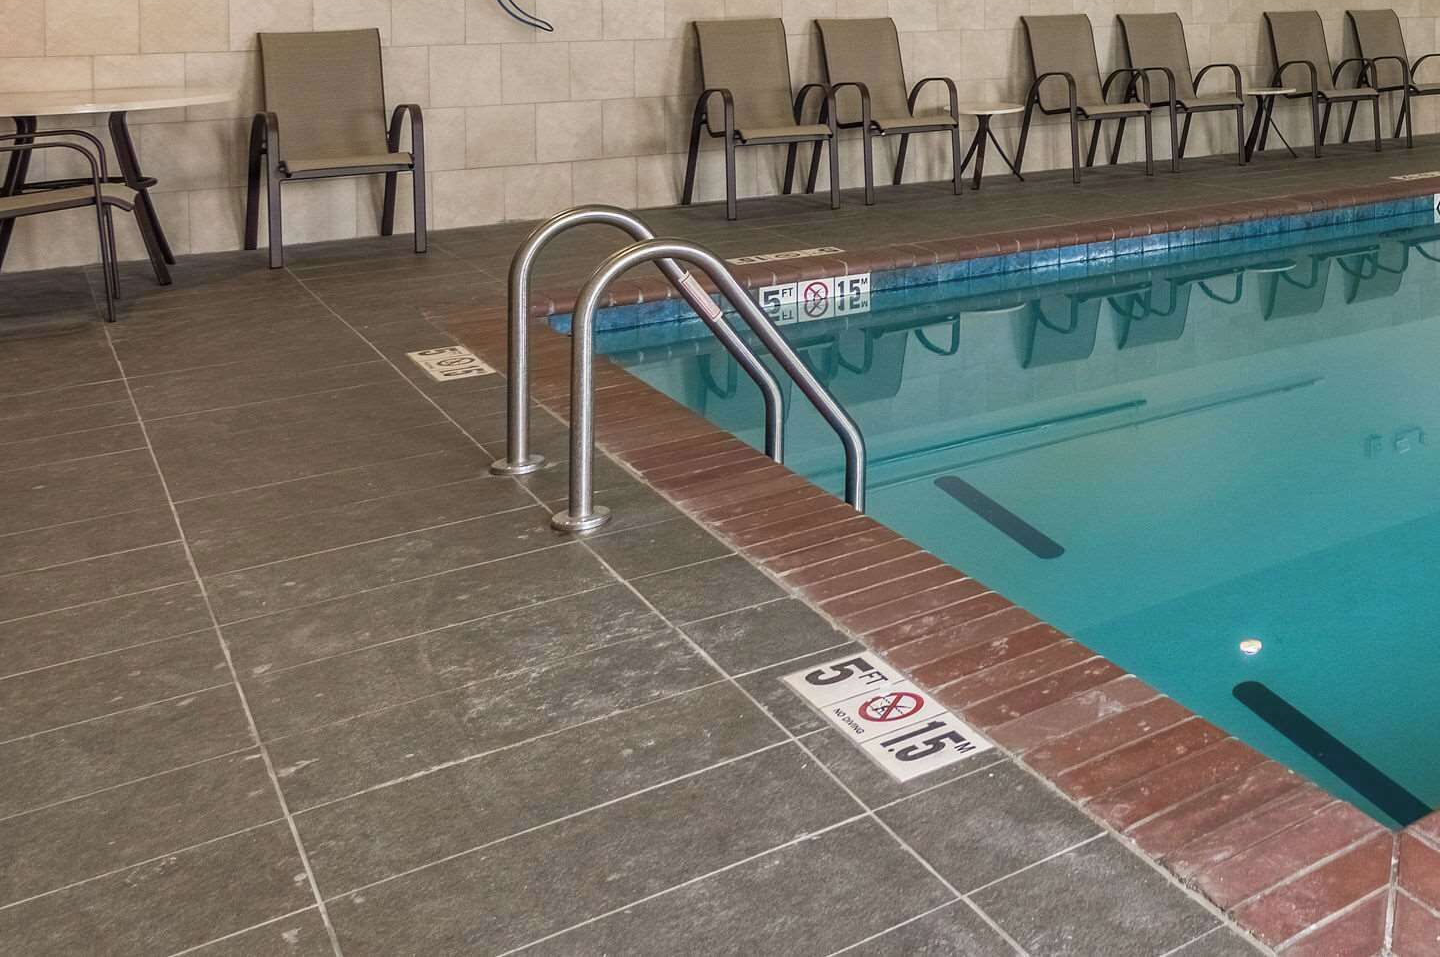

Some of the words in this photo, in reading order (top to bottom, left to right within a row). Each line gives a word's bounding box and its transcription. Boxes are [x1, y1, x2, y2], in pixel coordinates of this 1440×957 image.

[781, 287, 794, 298] FT
[860, 277, 868, 286] M
[804, 656, 875, 686] 5
[858, 670, 889, 685] FT
[880, 720, 967, 762] 1.5
[954, 741, 976, 754] M
